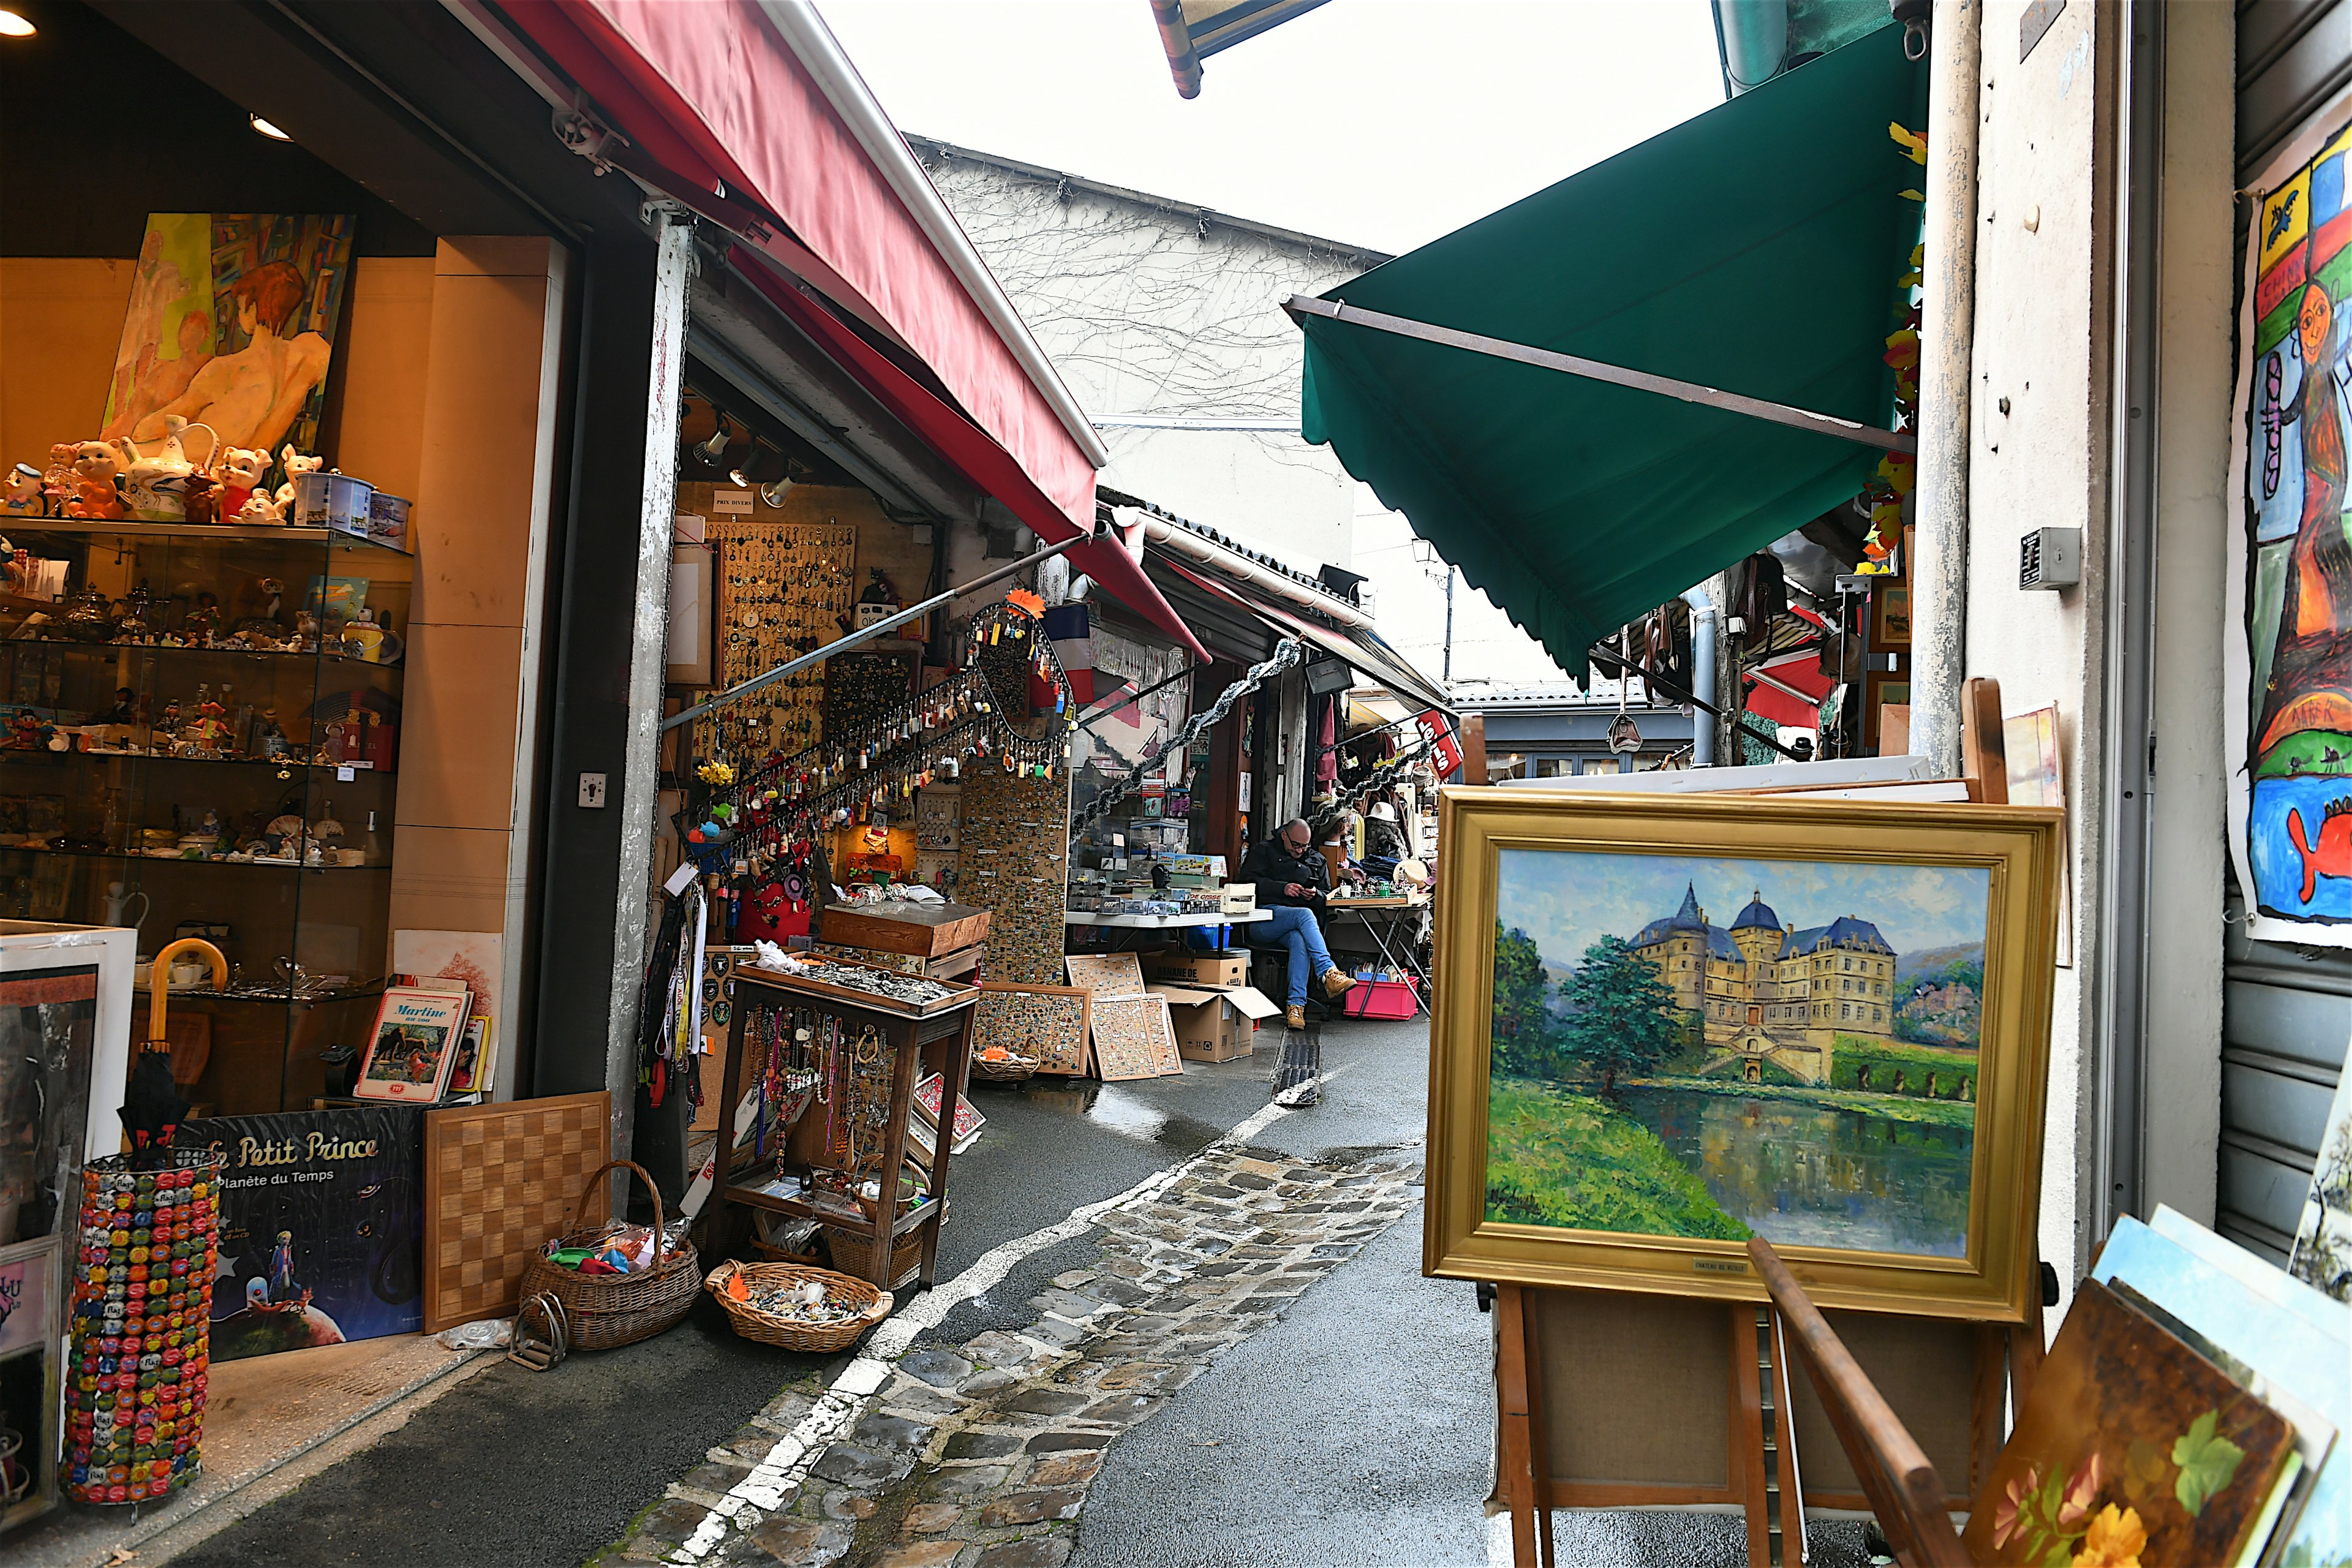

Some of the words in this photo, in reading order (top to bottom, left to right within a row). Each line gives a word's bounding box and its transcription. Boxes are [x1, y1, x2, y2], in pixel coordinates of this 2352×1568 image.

[1188, 968, 1197, 978] DE
[394, 1005, 447, 1019] Martine
[238, 1136, 298, 1168] Petit
[304, 1131, 379, 1163] Prince
[270, 1173, 289, 1185] du
[291, 1169, 334, 1183] Temps
